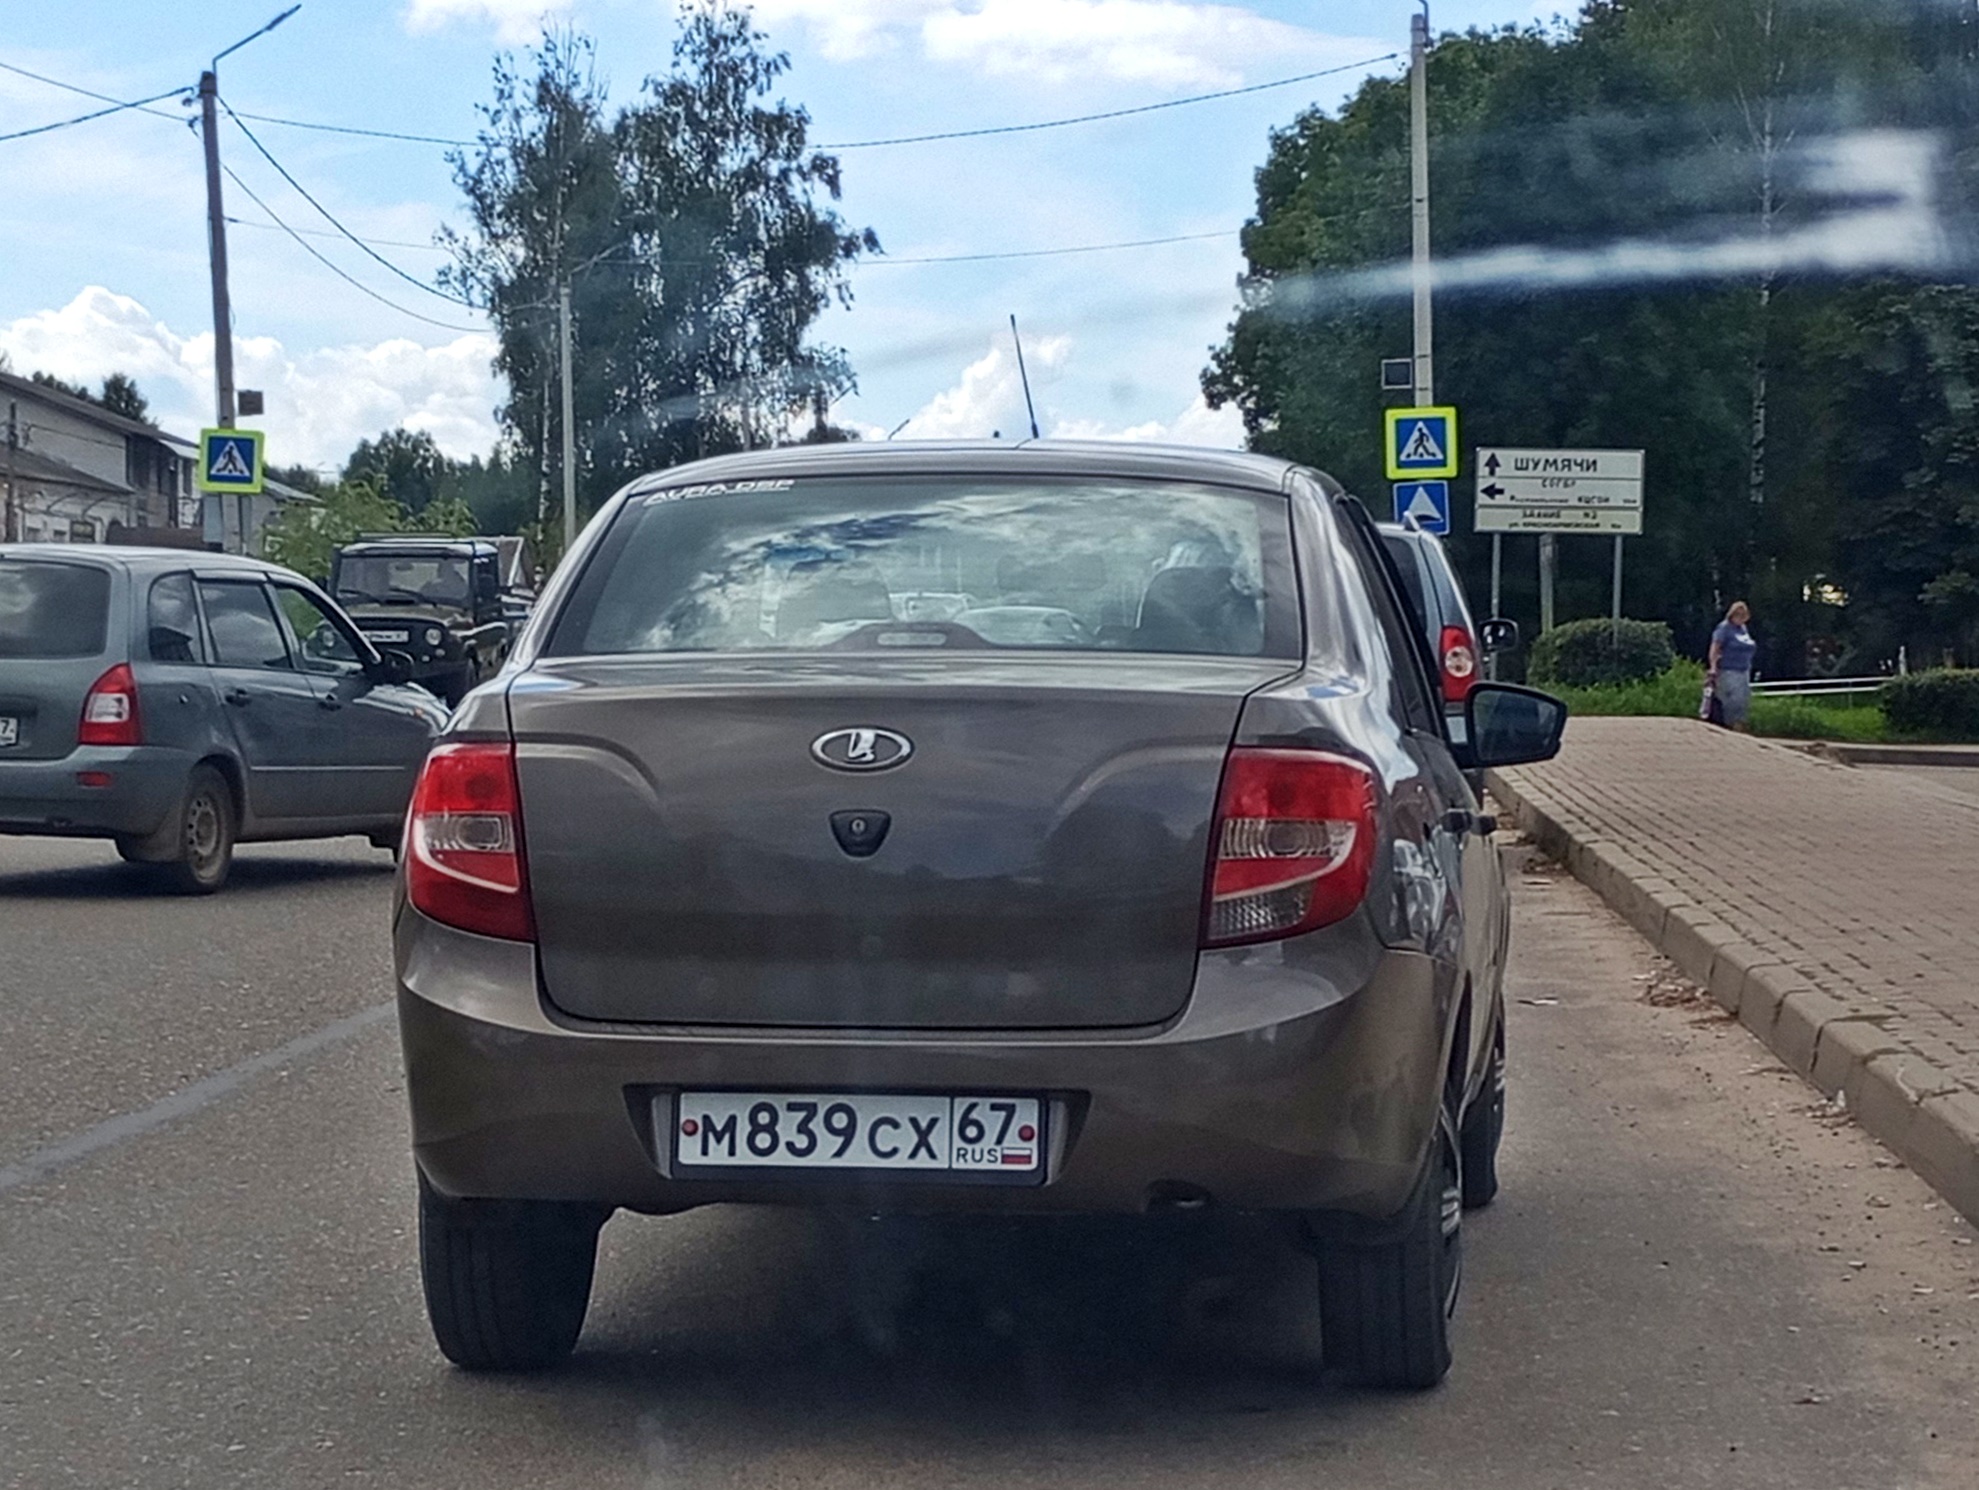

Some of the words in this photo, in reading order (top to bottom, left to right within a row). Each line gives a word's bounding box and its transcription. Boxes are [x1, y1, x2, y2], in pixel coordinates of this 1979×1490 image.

[1514, 457, 1598, 473] ШУМЯЧИ
[957, 1102, 1017, 1146] 67
[956, 1147, 999, 1164] RUS
